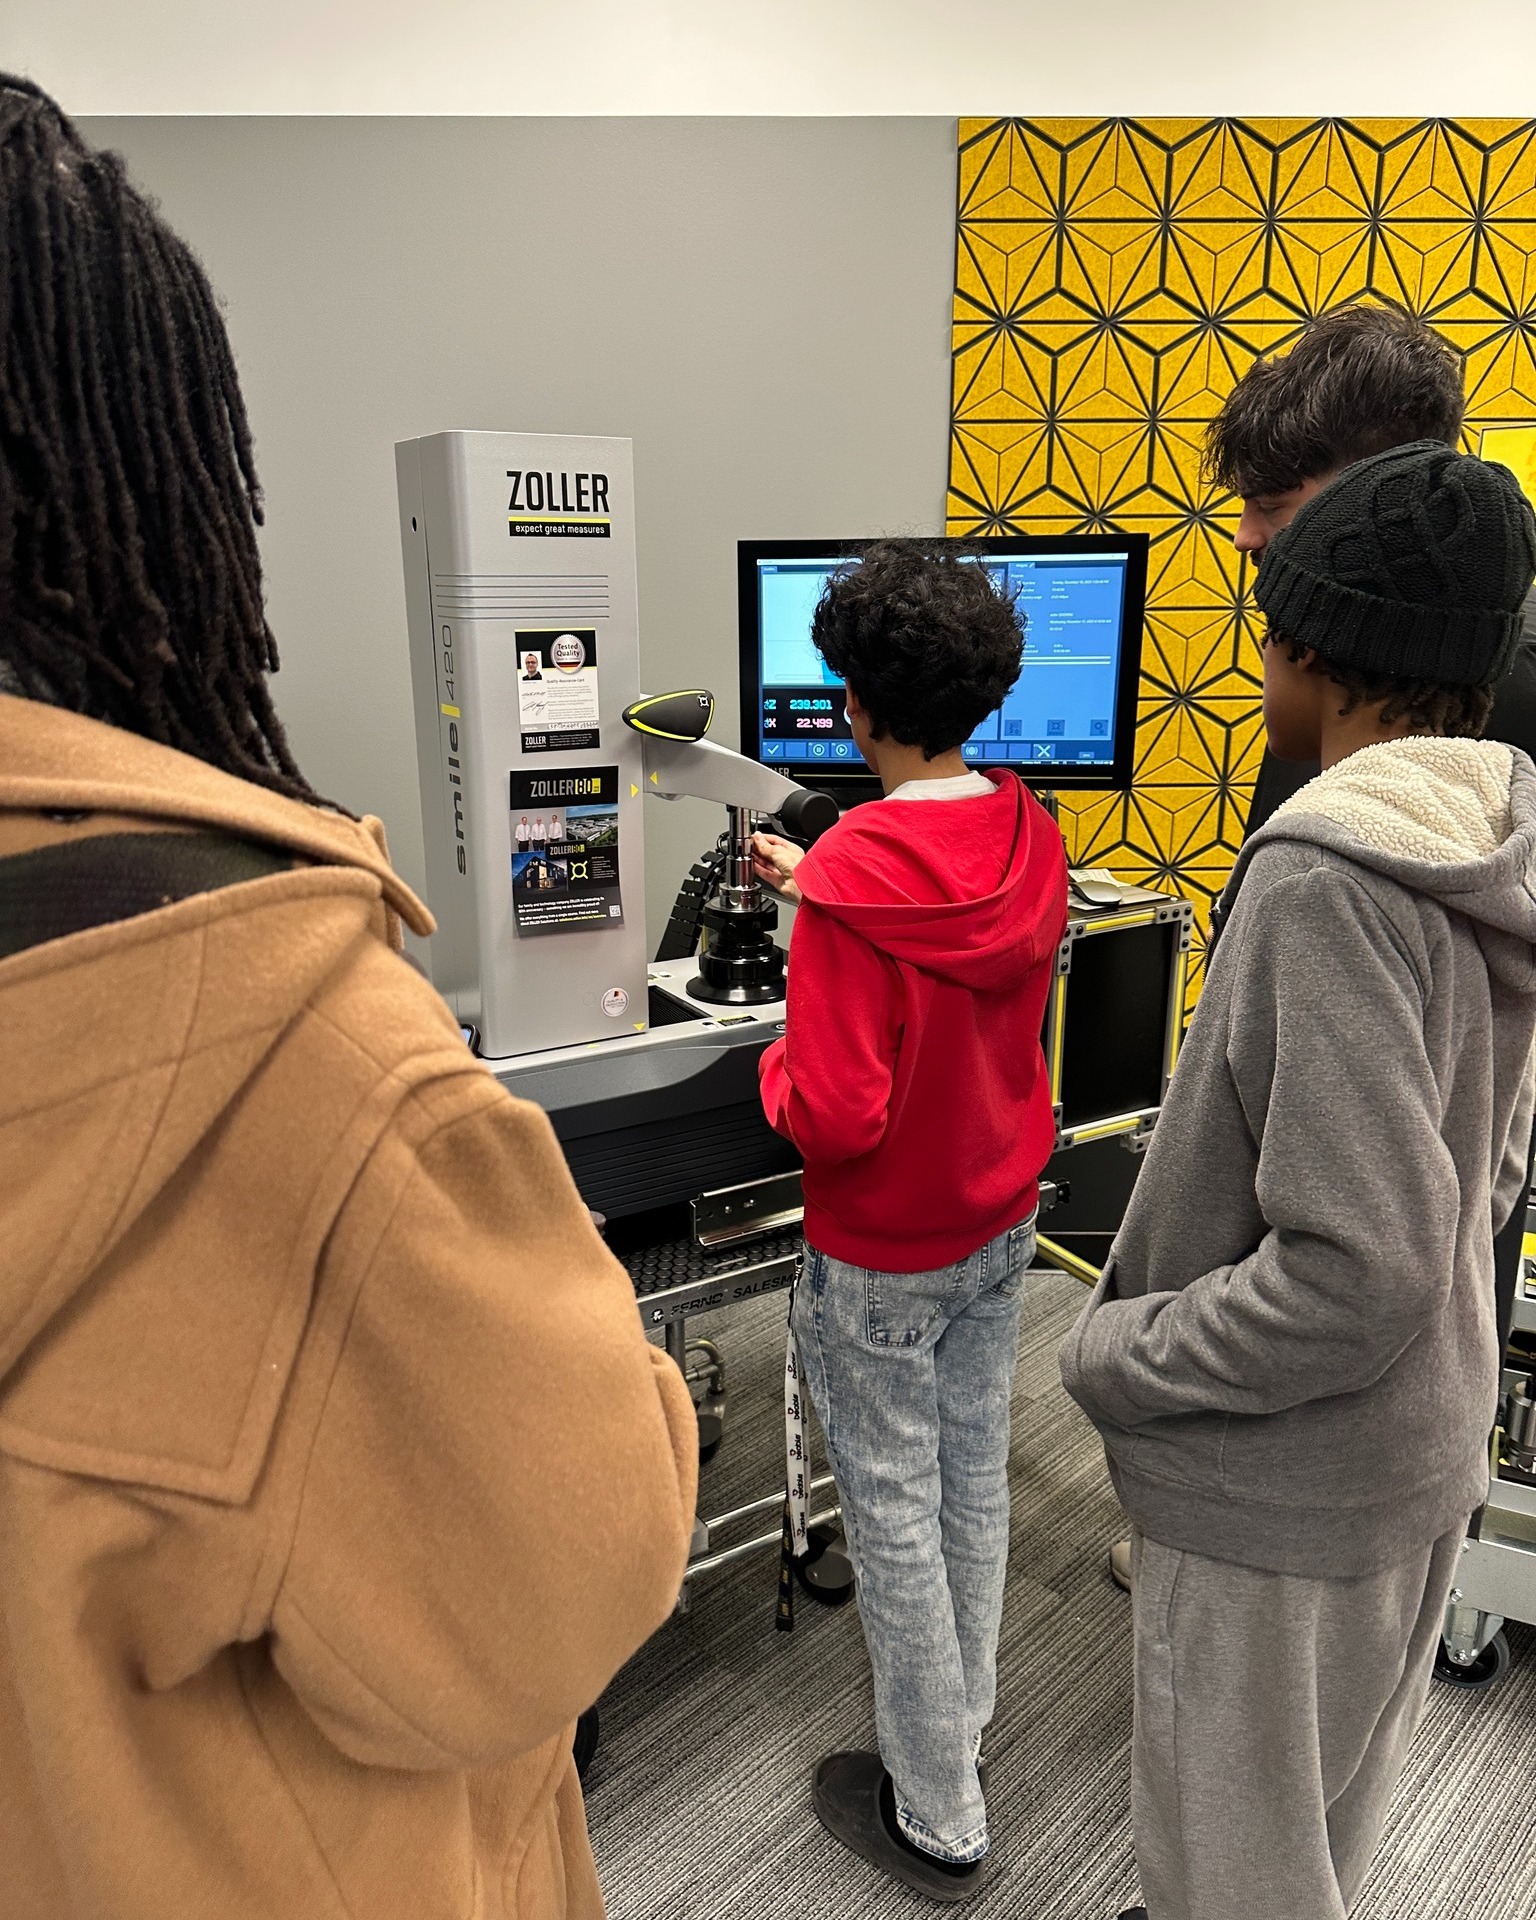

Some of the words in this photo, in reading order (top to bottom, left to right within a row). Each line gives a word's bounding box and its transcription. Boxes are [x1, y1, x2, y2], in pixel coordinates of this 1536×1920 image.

[507, 471, 609, 512] ZOLLER
[515, 525, 543, 534] expect
[545, 525, 565, 535] great
[567, 526, 605, 534] measures
[556, 649, 580, 658] Quality
[442, 624, 455, 701] 420
[768, 699, 777, 710] Z
[789, 699, 833, 710] 239.301
[768, 718, 777, 728] X
[796, 718, 833, 728] 22.499
[525, 736, 547, 745] ZOLLER
[448, 722, 467, 875] smile
